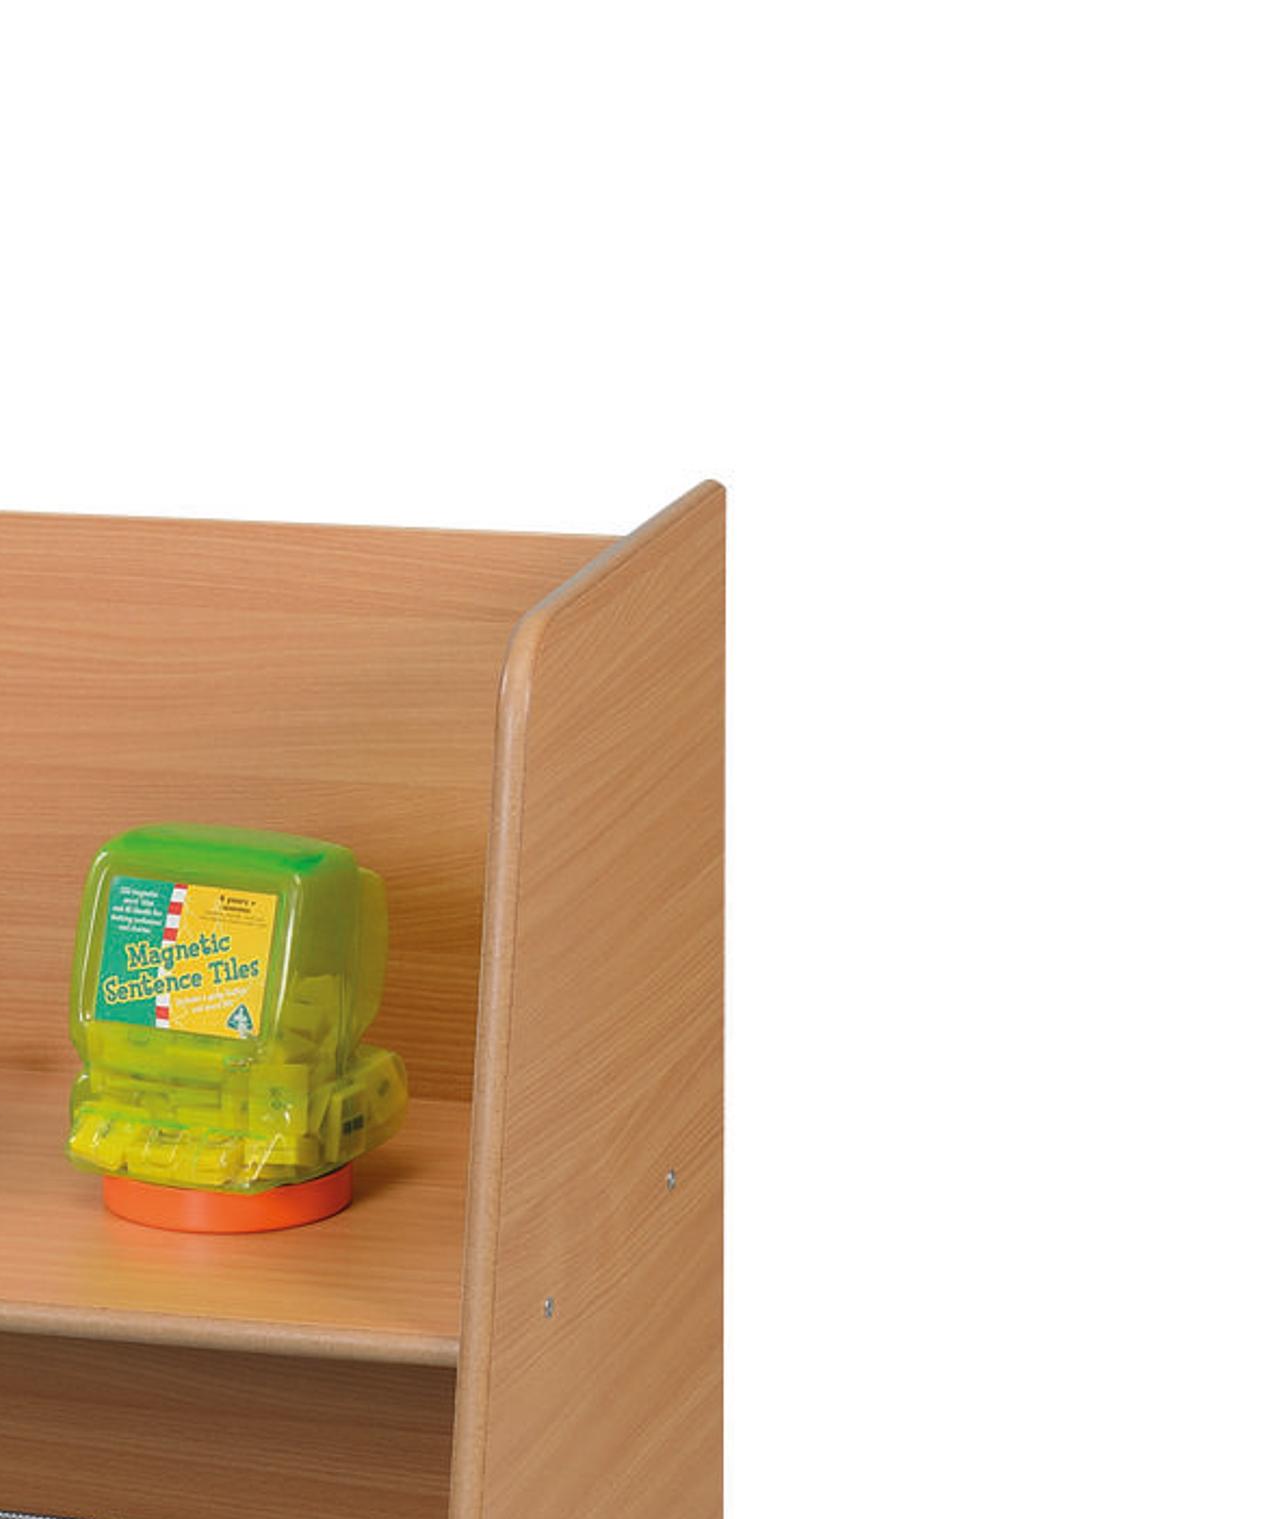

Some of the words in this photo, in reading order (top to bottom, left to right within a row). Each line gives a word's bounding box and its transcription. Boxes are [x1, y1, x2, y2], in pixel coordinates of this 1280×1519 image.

[125, 933, 231, 971] Magnetic
[104, 972, 203, 1004] Sentence
[207, 956, 260, 985] Tiles
